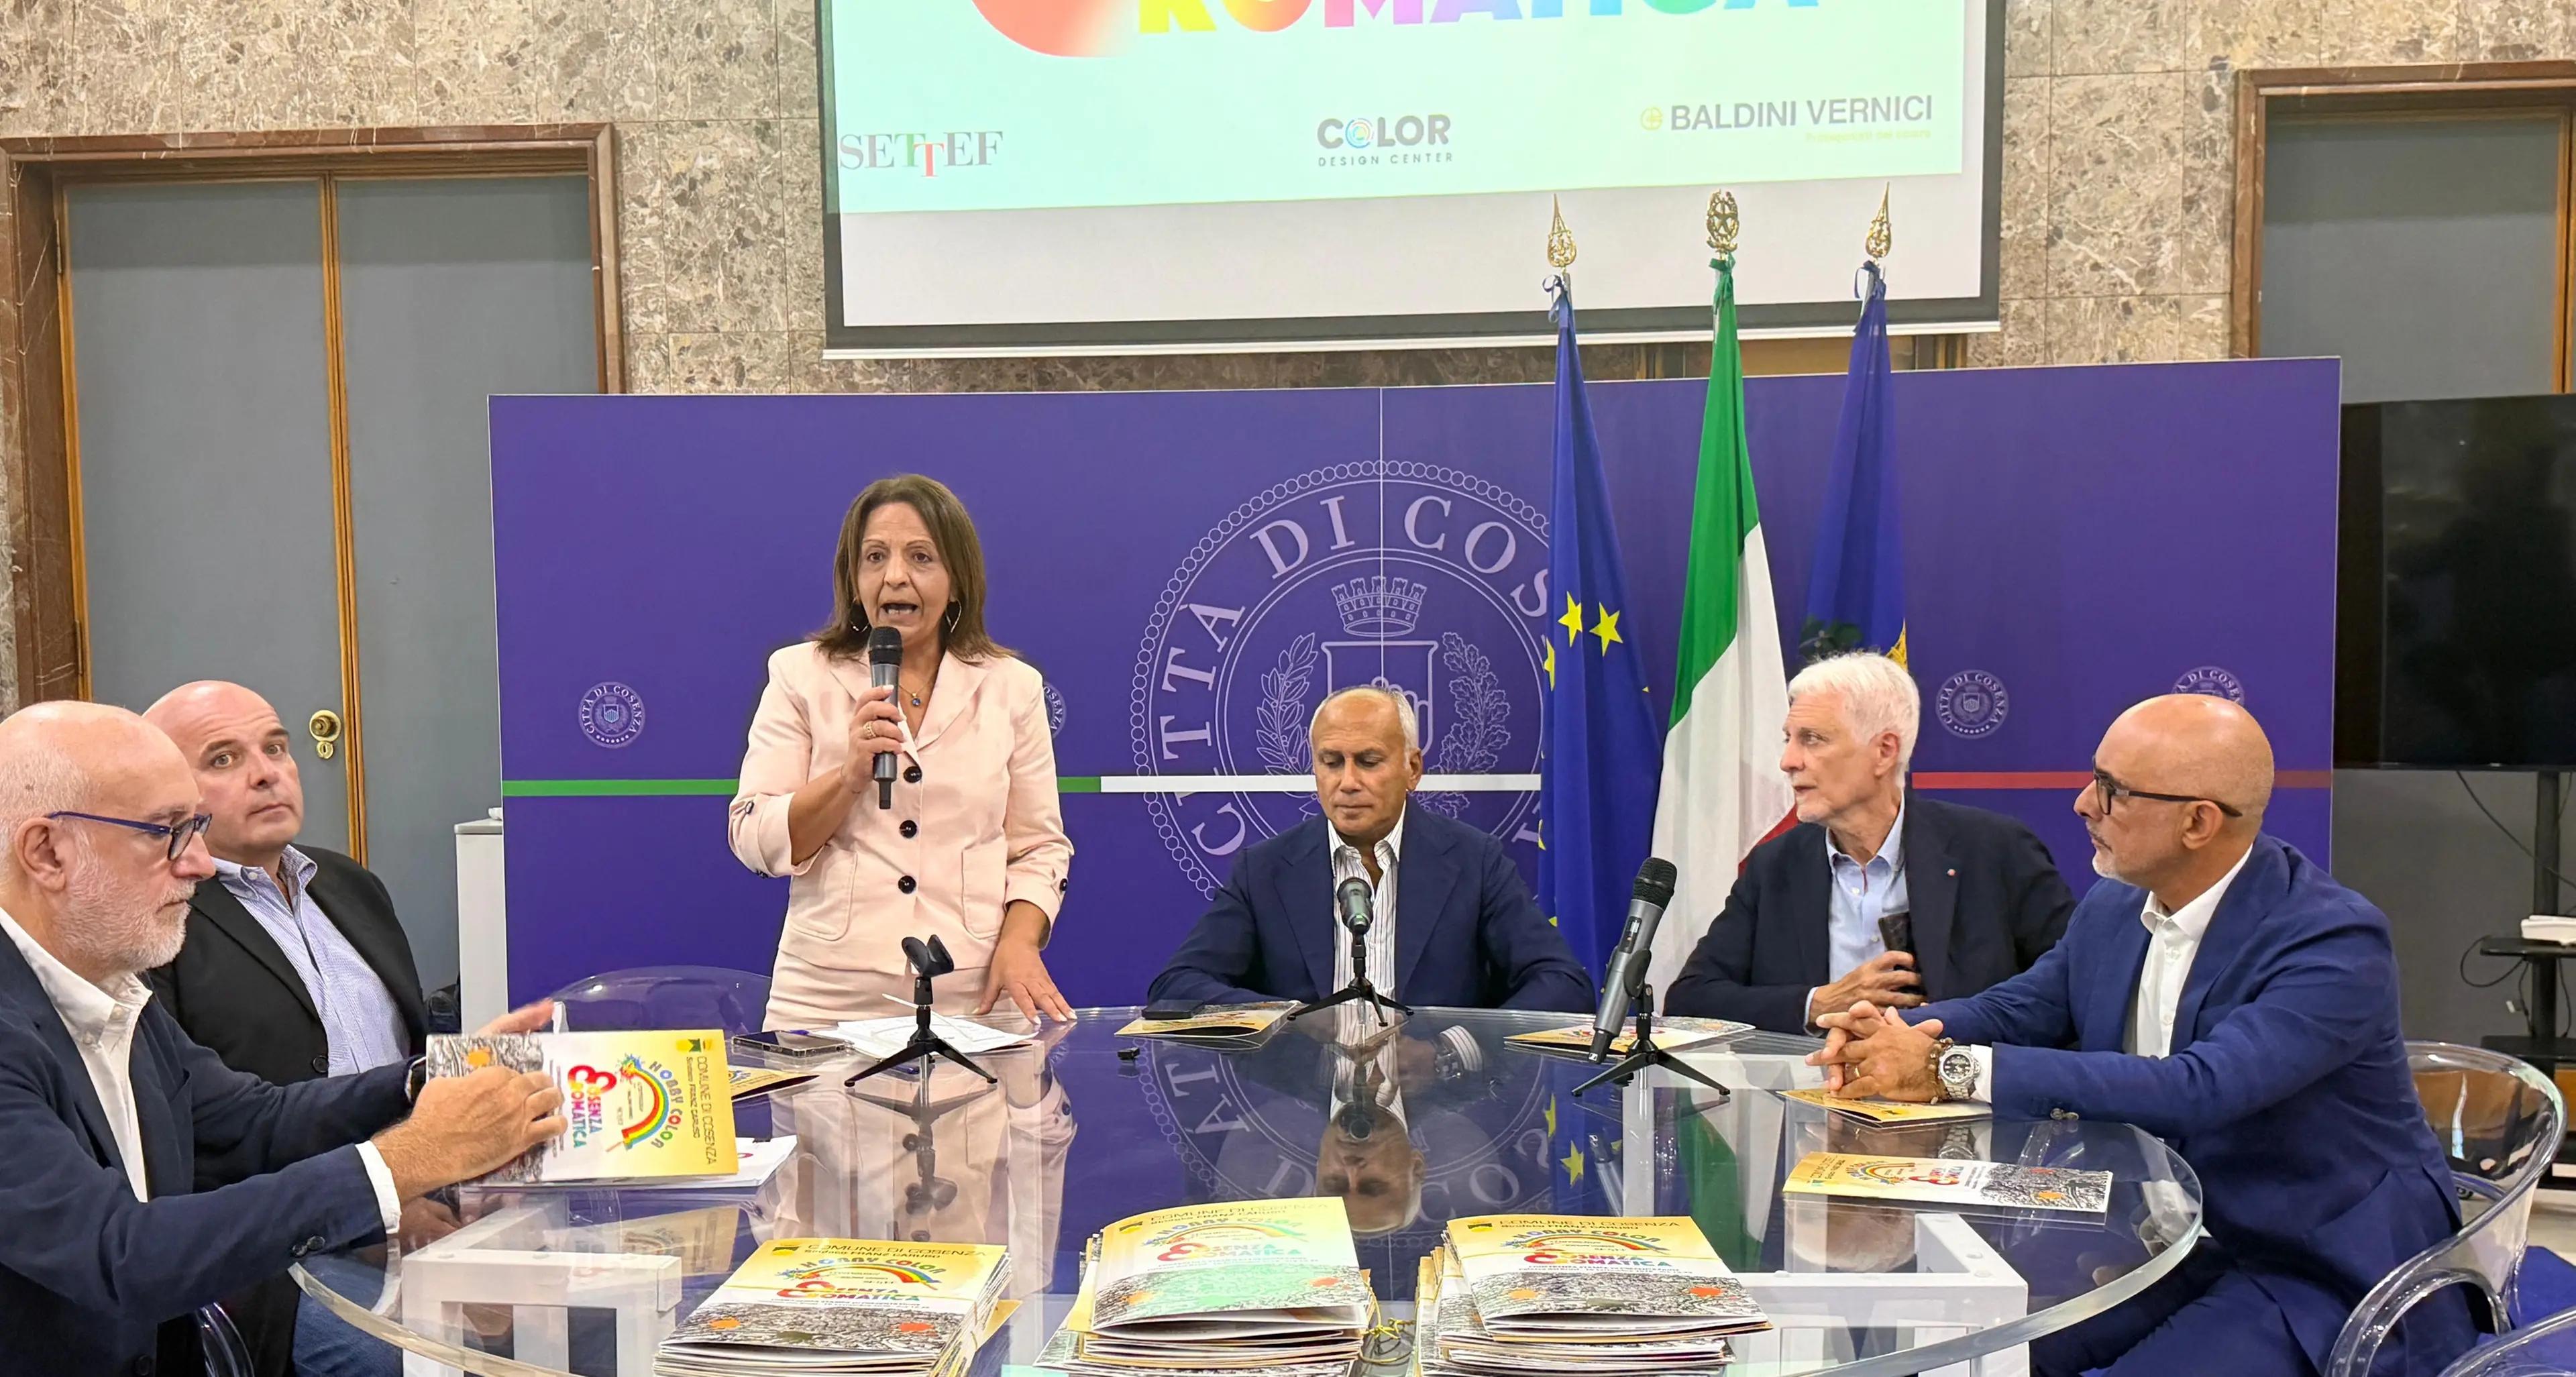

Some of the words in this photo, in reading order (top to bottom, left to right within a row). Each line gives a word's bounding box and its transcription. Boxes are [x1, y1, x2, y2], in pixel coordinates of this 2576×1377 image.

[1317, 114, 1451, 149] COLOR
[1670, 101, 1797, 131] BALDINI
[1806, 95, 1933, 125] VERNICI
[839, 131, 1004, 178] SETTEF
[1318, 156, 1379, 167] DESIGN
[1390, 152, 1452, 164] CENTER
[1249, 496, 1356, 580] DI
[593, 685, 607, 698] DI
[613, 685, 642, 733] COSENZA
[1043, 685, 1063, 730] OSENZA
[1953, 673, 1969, 685] DI
[1974, 673, 2005, 723] COSENZA
[648, 1060, 684, 1104] HOBBY
[651, 1107, 684, 1149] COLOR
